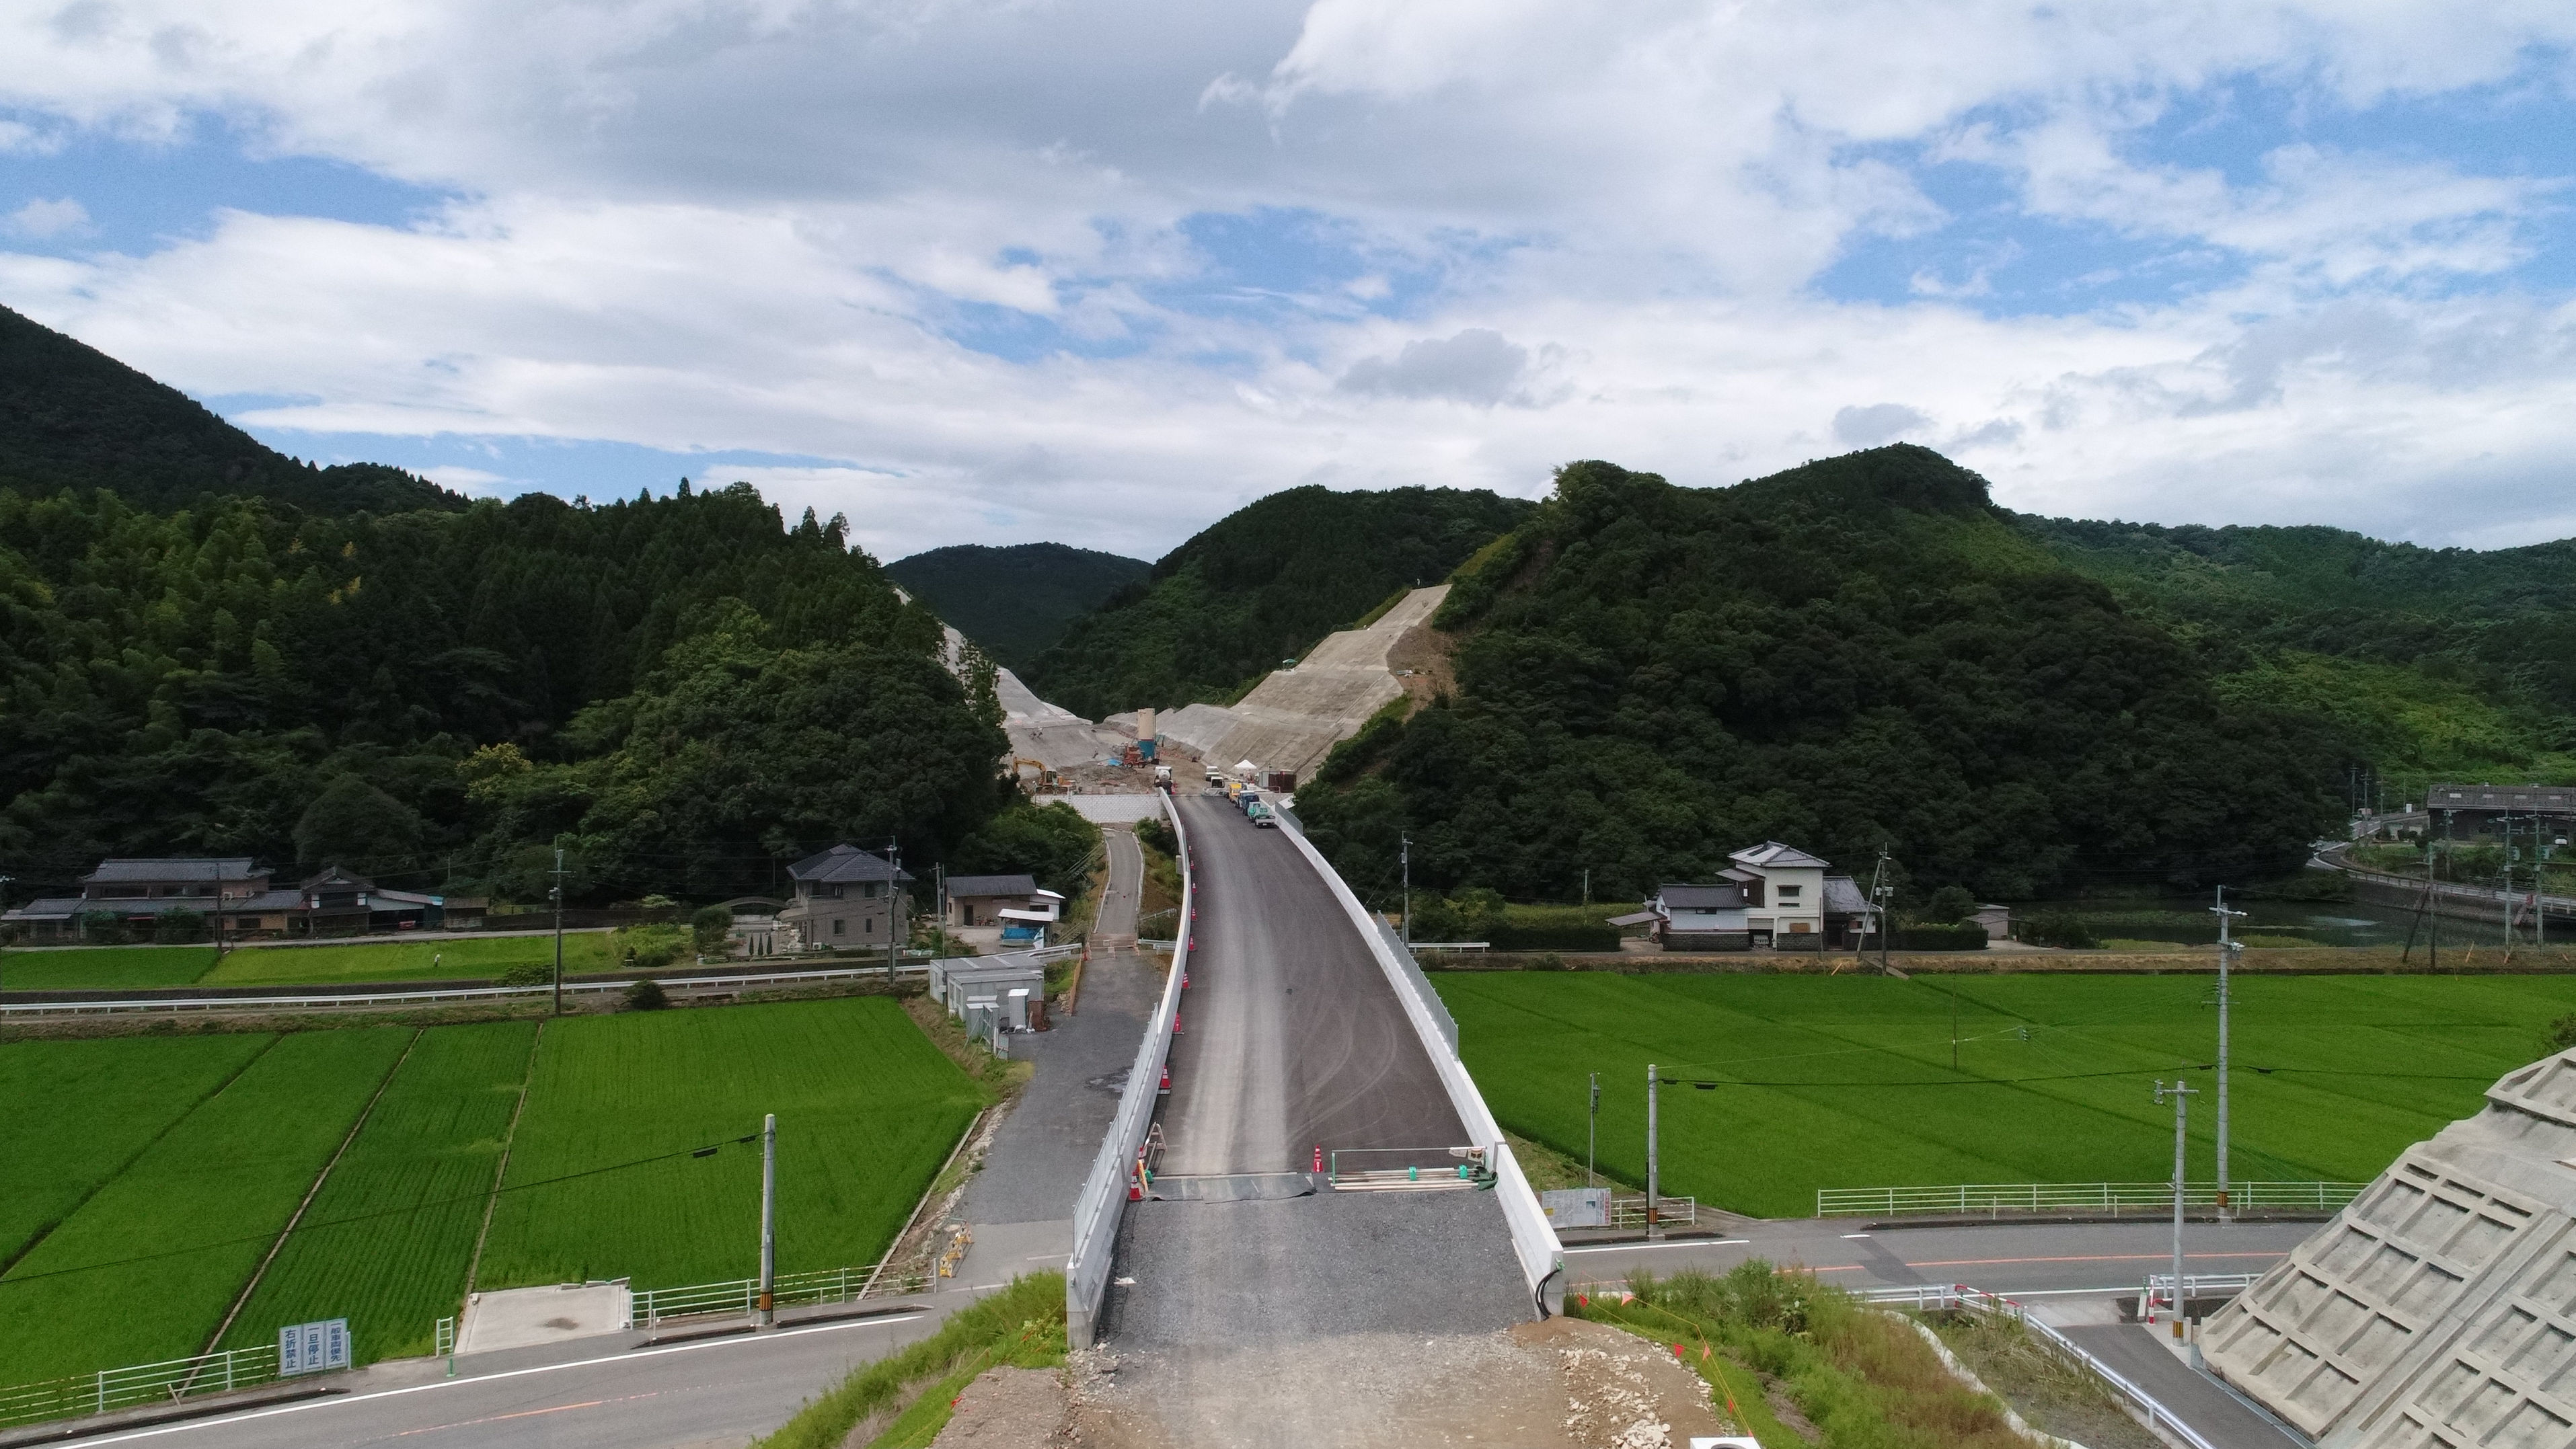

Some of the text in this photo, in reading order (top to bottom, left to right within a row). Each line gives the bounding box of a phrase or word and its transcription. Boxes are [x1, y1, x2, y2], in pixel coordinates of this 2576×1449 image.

[285, 1329, 297, 1369] 右折禁止
[307, 1327, 319, 1366] 一旦停止
[330, 1323, 342, 1362] 一般車両優先
